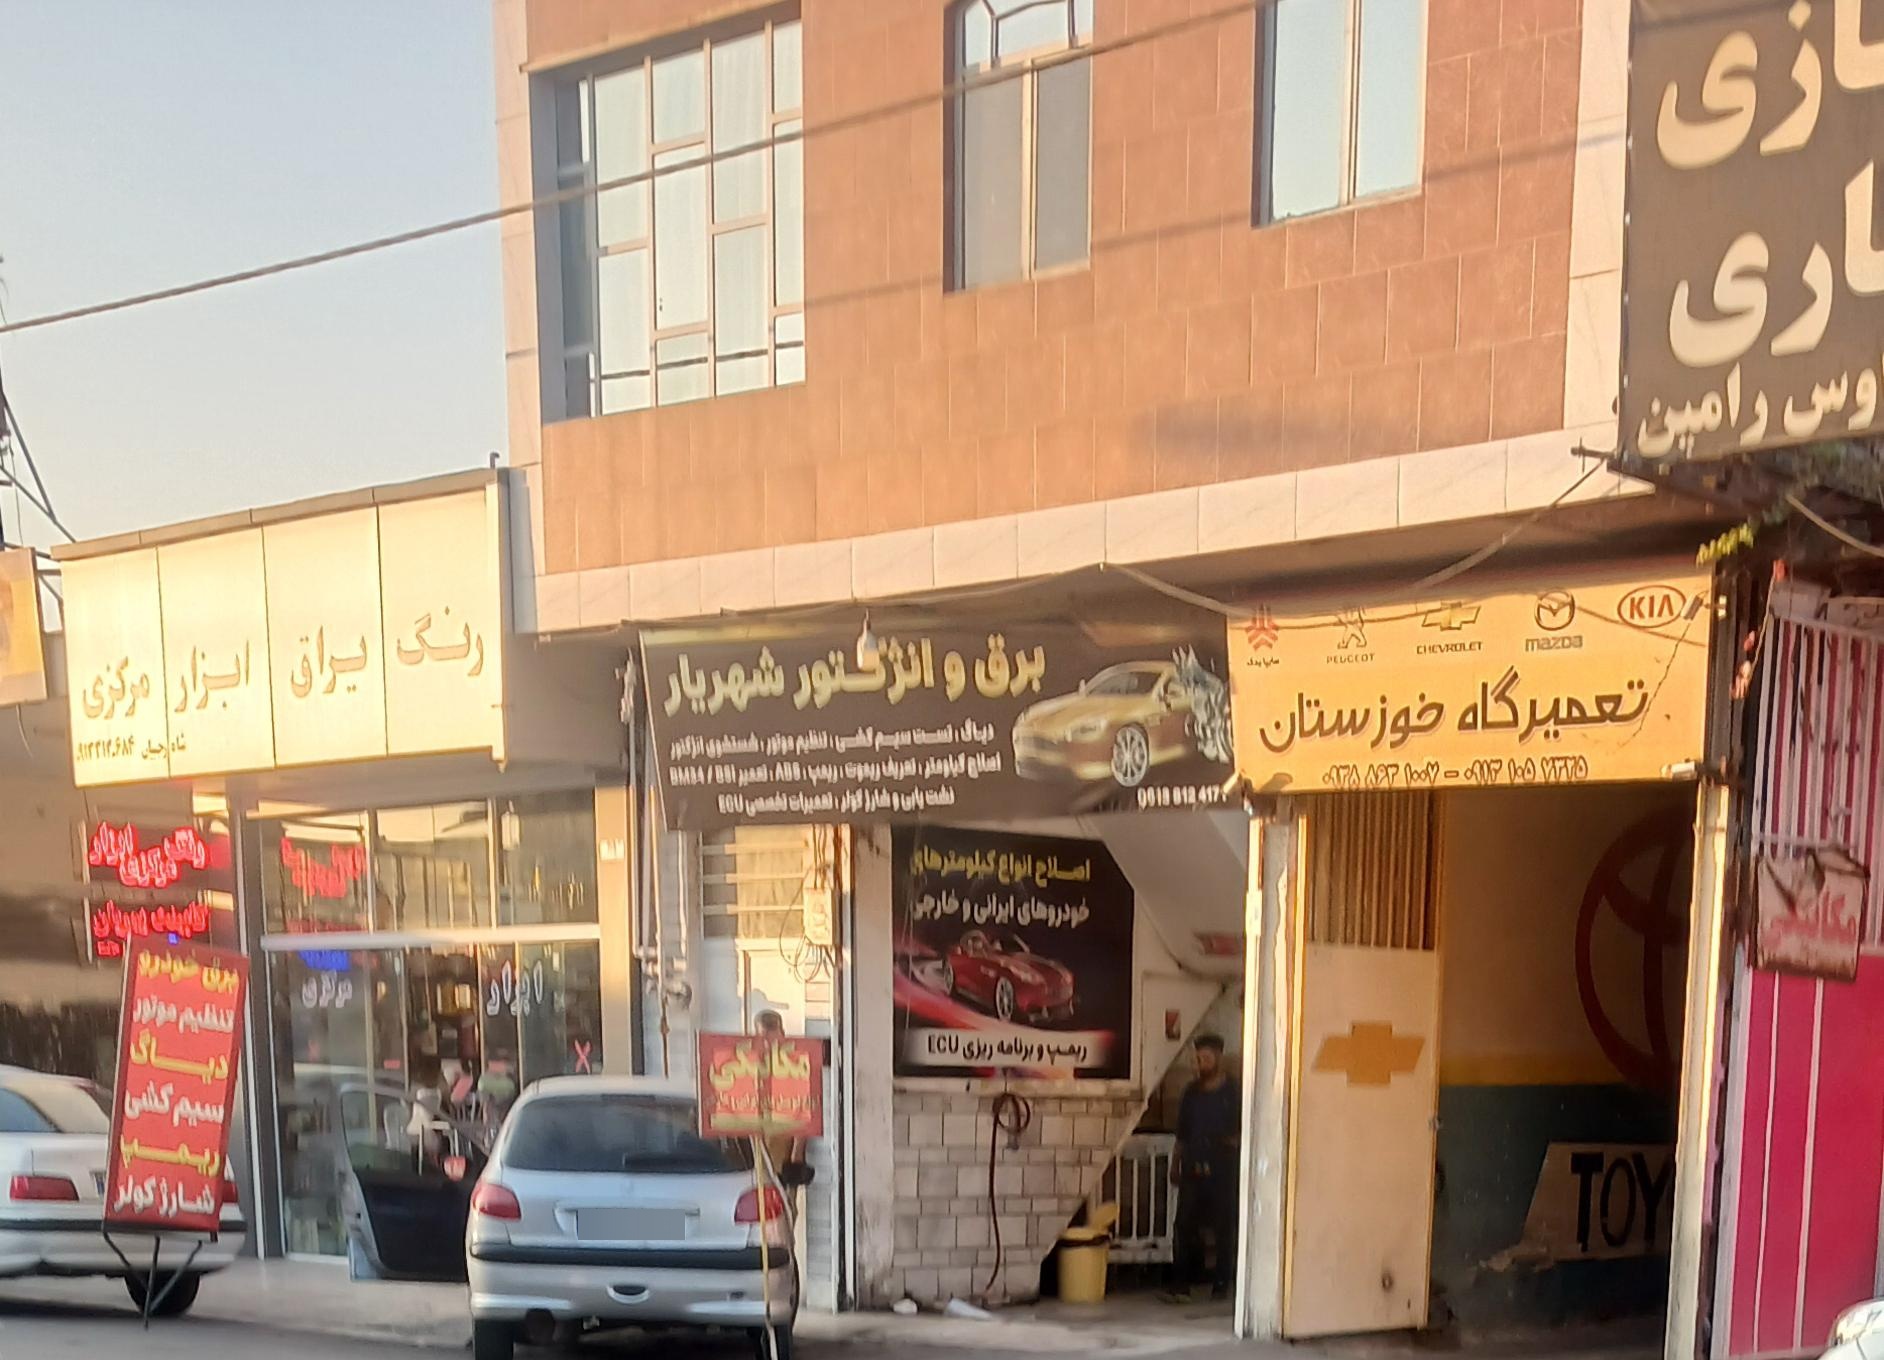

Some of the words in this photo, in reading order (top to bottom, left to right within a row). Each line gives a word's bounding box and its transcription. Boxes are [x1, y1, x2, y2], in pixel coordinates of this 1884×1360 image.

[1657, 0, 1884, 170] ازی
[1669, 159, 1884, 368] اری
[1637, 362, 1768, 458] رامین
[1783, 354, 1884, 438] وس
[1628, 595, 1676, 621] KIA
[290, 625, 368, 698] یراق
[396, 606, 485, 678] رنگ
[1326, 653, 1376, 665] PEUGEOT
[1416, 640, 1484, 656] CHEVROLET
[174, 640, 251, 713] ابزار
[664, 646, 784, 716] شهریار
[793, 636, 934, 709] انژکتور
[943, 650, 967, 700] و
[974, 633, 1046, 697] برق
[82, 656, 151, 720] مرکزی
[1457, 664, 1649, 745] تعمیرگاه
[1258, 691, 1446, 754] خوزستان
[998, 850, 1033, 886] انواع
[1034, 854, 1091, 888] اصلاح
[962, 897, 971, 917] و
[973, 891, 1015, 926] ایرانی
[1016, 894, 1090, 928] خودروهای
[137, 949, 199, 984] خودرو
[201, 955, 240, 993] برق
[132, 993, 178, 1028] موتور
[178, 997, 235, 1035] تنظیم
[130, 1027, 229, 1083] دیاگ
[708, 1039, 811, 1091] مکانیکی
[927, 1034, 960, 1054] ECU
[962, 1036, 994, 1061] ریزی
[996, 1036, 1034, 1061] برنامه
[1036, 1041, 1045, 1060] و
[1049, 1038, 1088, 1066] ریمپ
[122, 1078, 174, 1121] کشی
[172, 1092, 225, 1128] سیم
[120, 1132, 221, 1178] ریمپ
[112, 1173, 158, 1215] کولر
[157, 1177, 216, 1219] شارژ
